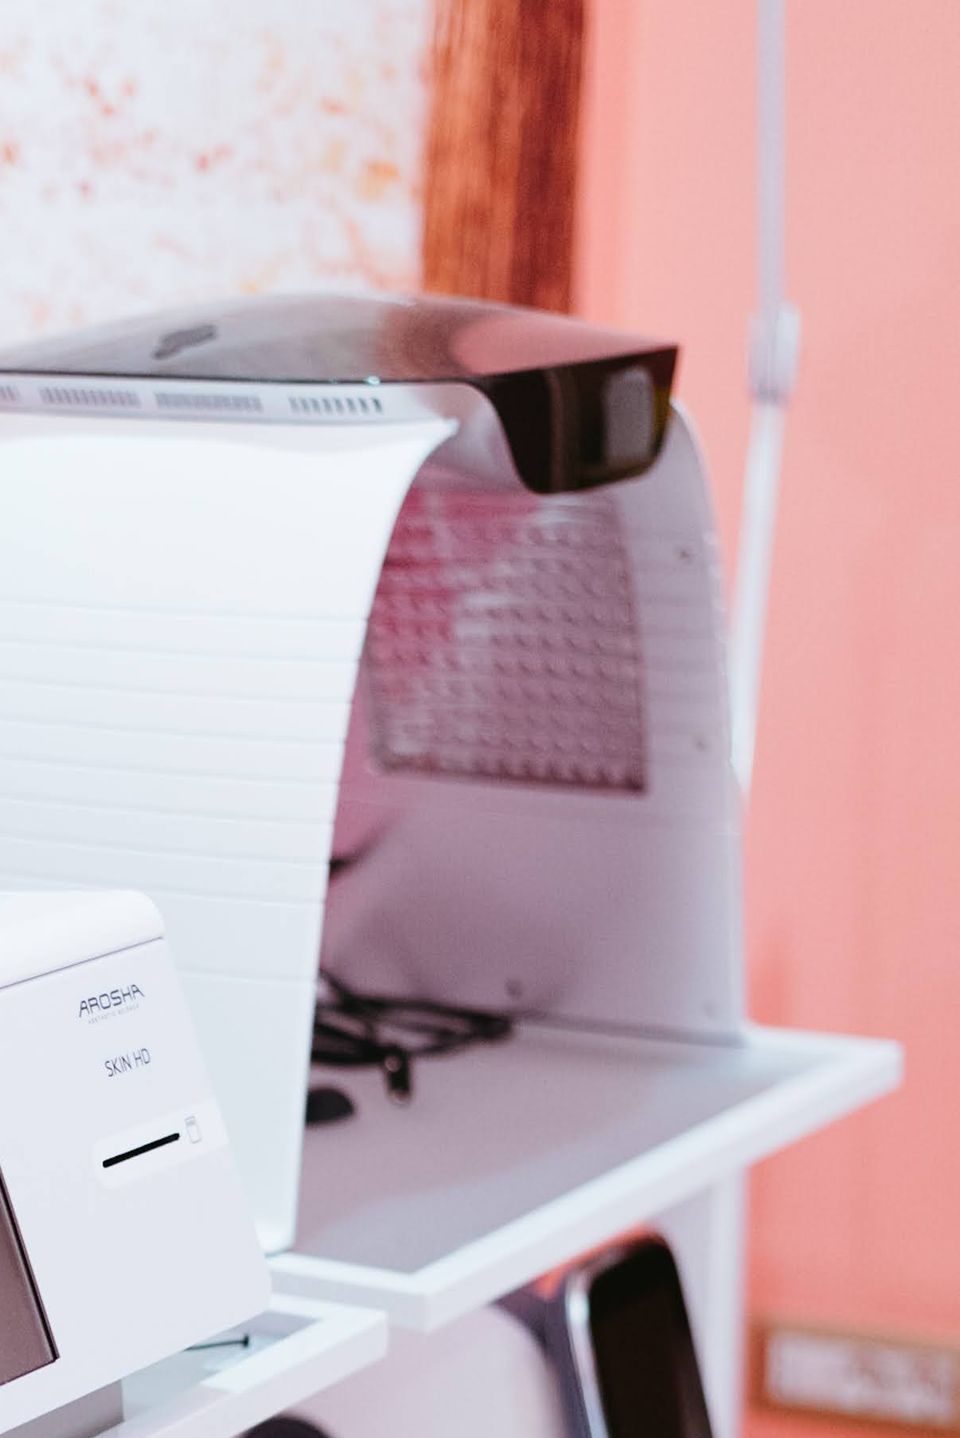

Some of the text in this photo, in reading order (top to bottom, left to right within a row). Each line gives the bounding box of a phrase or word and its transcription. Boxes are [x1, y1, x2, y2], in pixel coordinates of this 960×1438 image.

[79, 984, 145, 1018] AROSHA
[104, 1048, 151, 1077] SKIN HD
